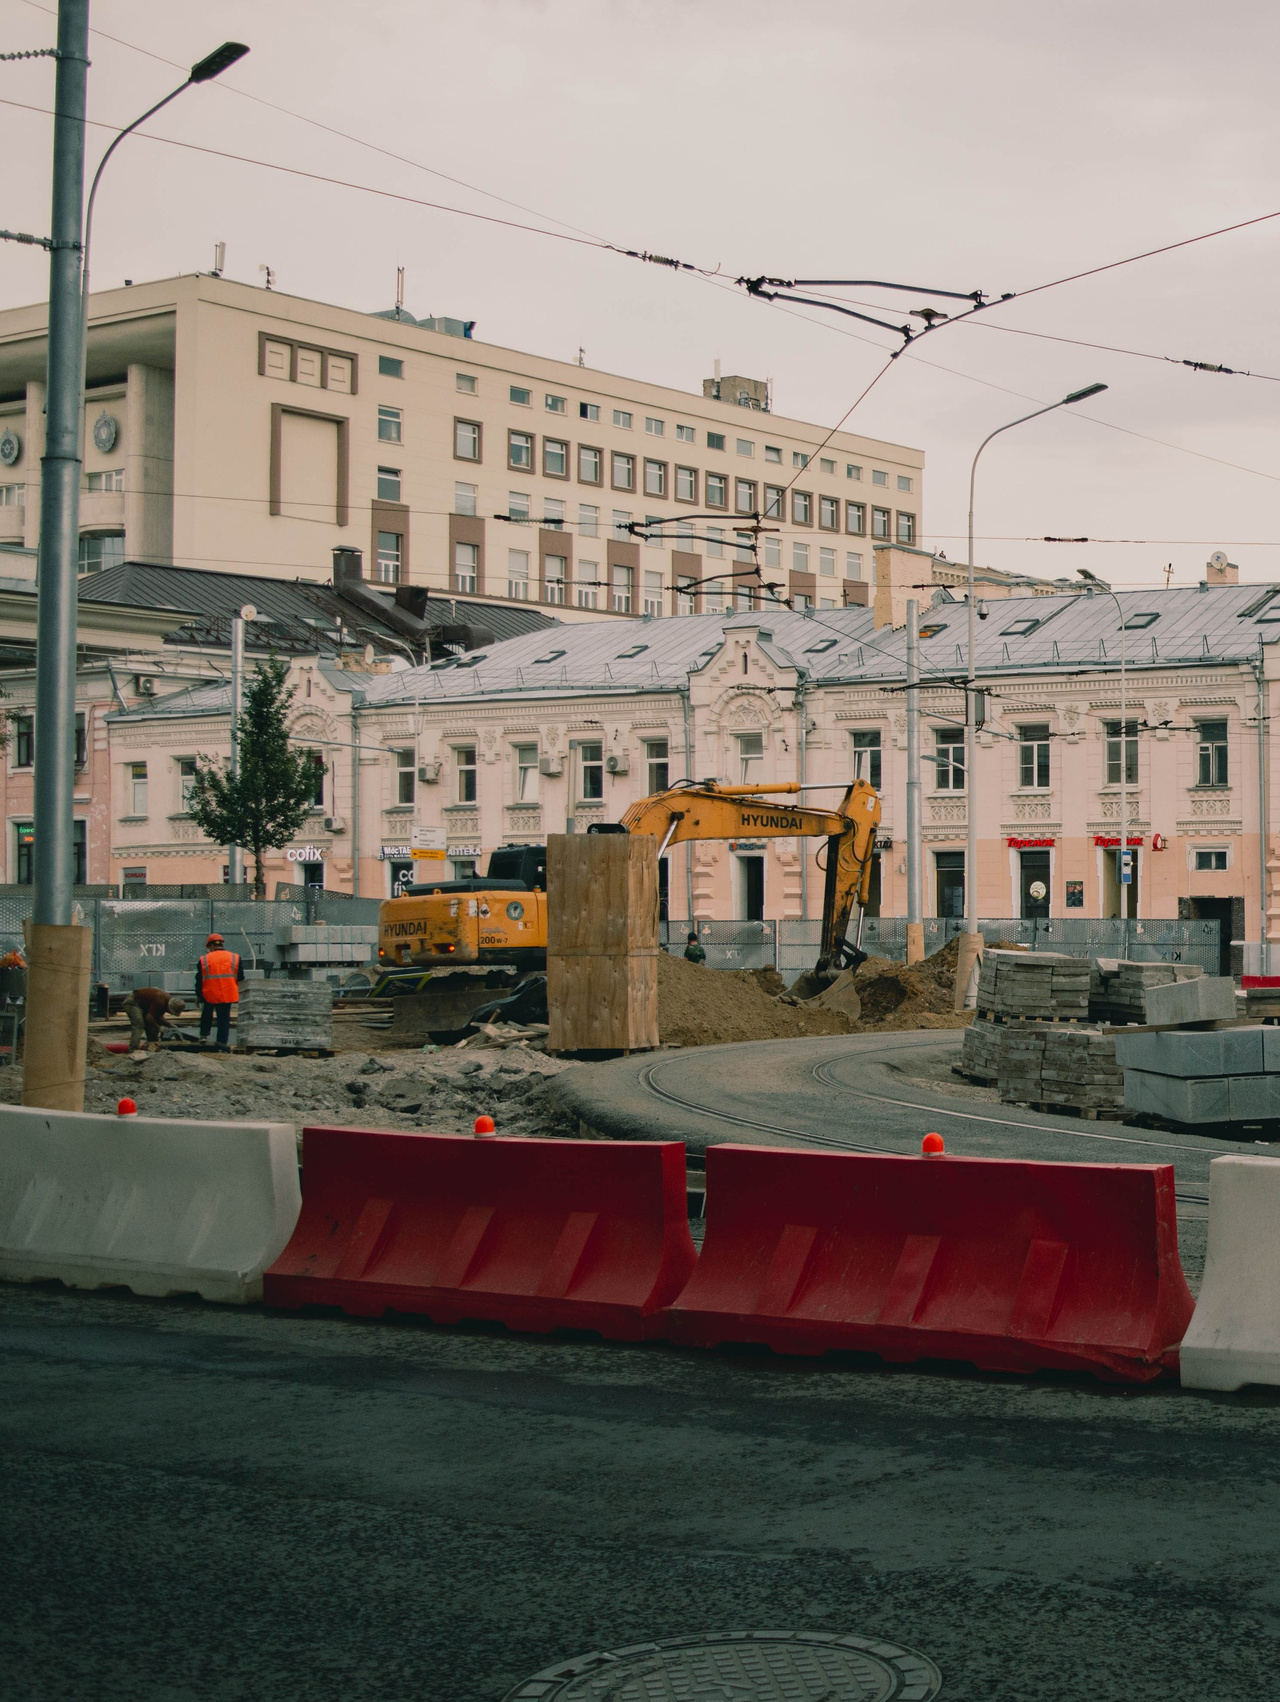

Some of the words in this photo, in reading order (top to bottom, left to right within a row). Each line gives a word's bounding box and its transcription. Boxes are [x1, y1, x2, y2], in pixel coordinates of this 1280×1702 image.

[741, 813, 803, 830] HYUNDAI
[1092, 836, 1144, 848] Тереок
[286, 845, 323, 861] cofix
[446, 847, 482, 856] АПТЕКА
[384, 921, 428, 937] HYUNDAI
